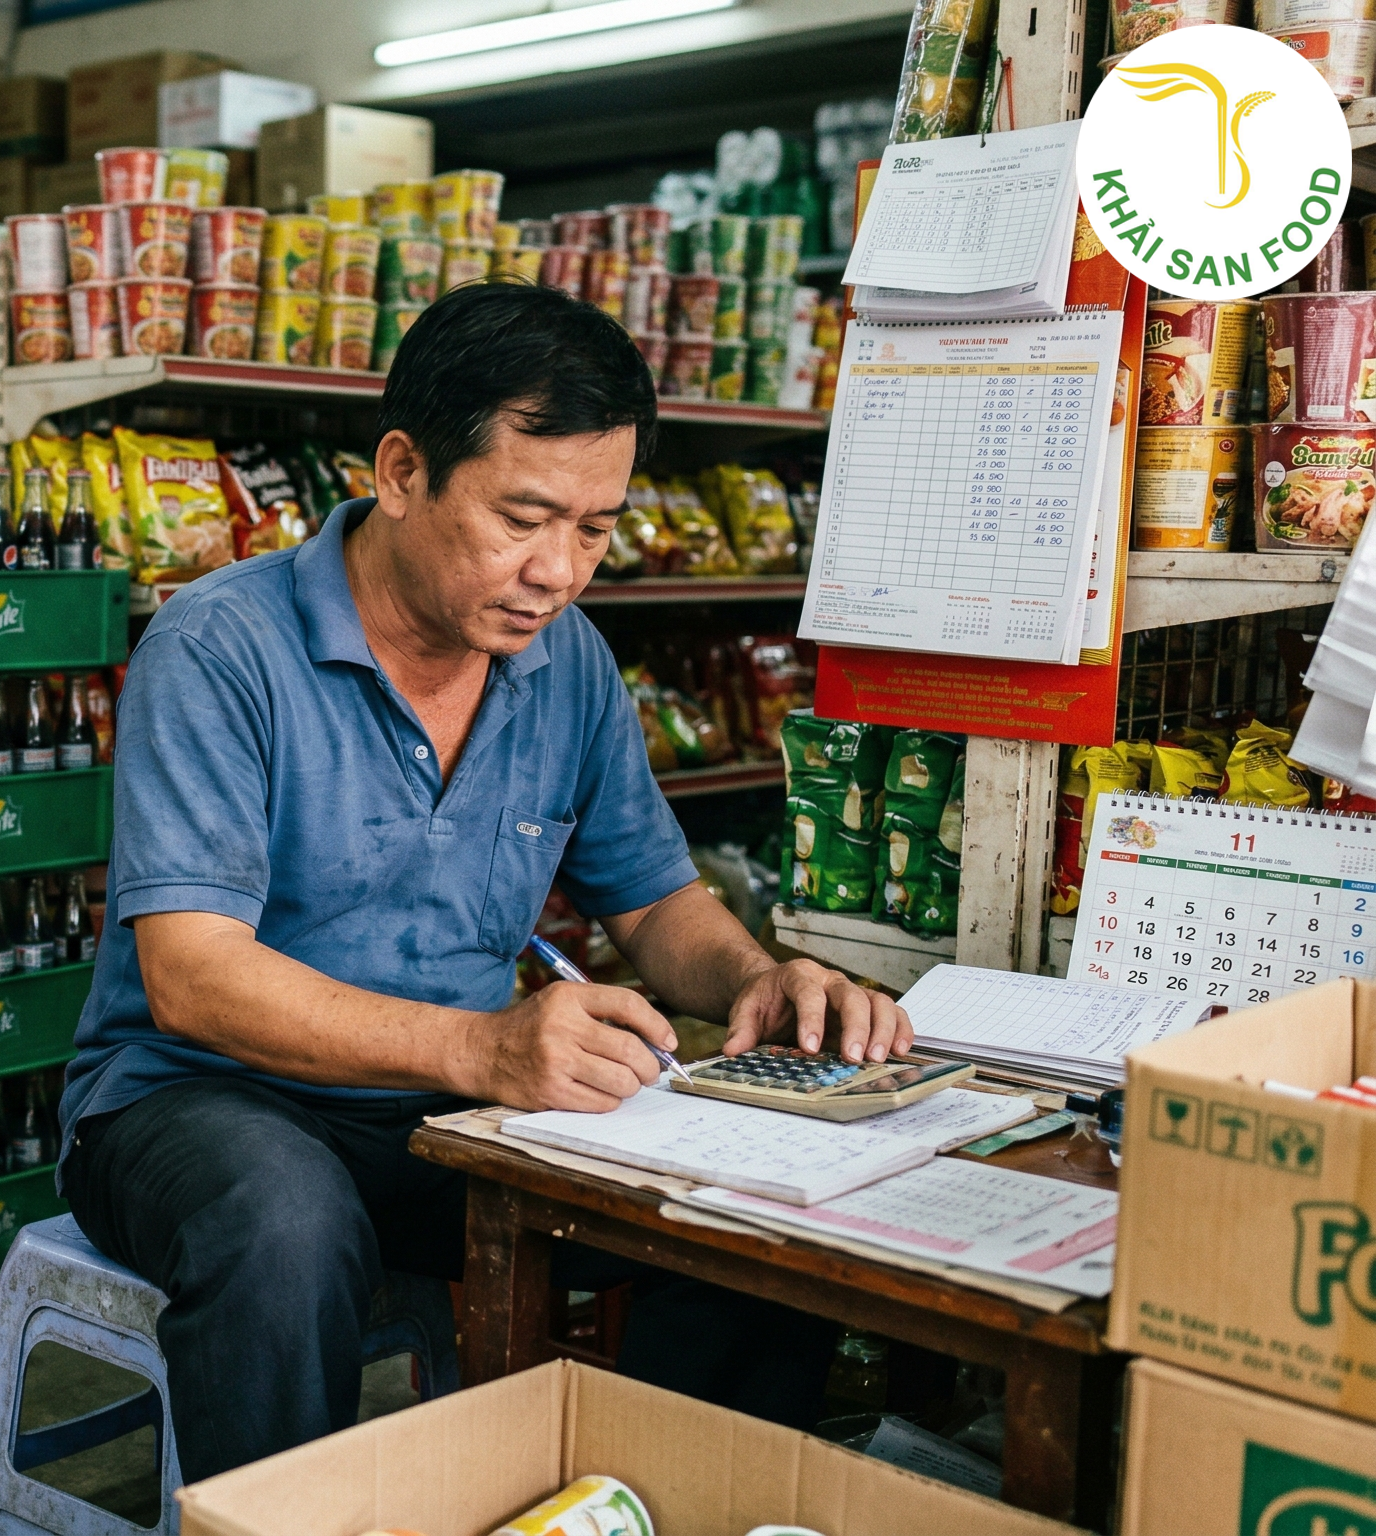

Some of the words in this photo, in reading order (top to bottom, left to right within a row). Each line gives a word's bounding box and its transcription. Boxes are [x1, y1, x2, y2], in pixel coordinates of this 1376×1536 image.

[1230, 832, 1256, 853] 11
[1106, 891, 1117, 904] 3
[1144, 896, 1155, 909] 4
[1184, 901, 1195, 915] 5
[1224, 907, 1235, 920] 6
[1266, 912, 1277, 925] 7
[1308, 918, 1319, 932] 8
[1351, 923, 1363, 938] 9
[1313, 892, 1321, 905] 1
[1354, 898, 1367, 912] 2
[1098, 915, 1118, 930] 10
[1176, 926, 1196, 941] 12
[1215, 932, 1236, 946] 13
[1257, 937, 1277, 952] 14
[1299, 943, 1321, 959] 15
[1343, 950, 1364, 965] 16
[1094, 940, 1114, 954] 17
[1133, 945, 1152, 960] 18
[1172, 951, 1192, 966] 19
[1210, 956, 1233, 972] 20
[1251, 963, 1272, 978] 21
[1293, 969, 1317, 985] 22
[1127, 970, 1148, 985] 25
[1166, 976, 1188, 991] 26
[1206, 982, 1230, 997] 27
[1247, 988, 1270, 1003] 28
